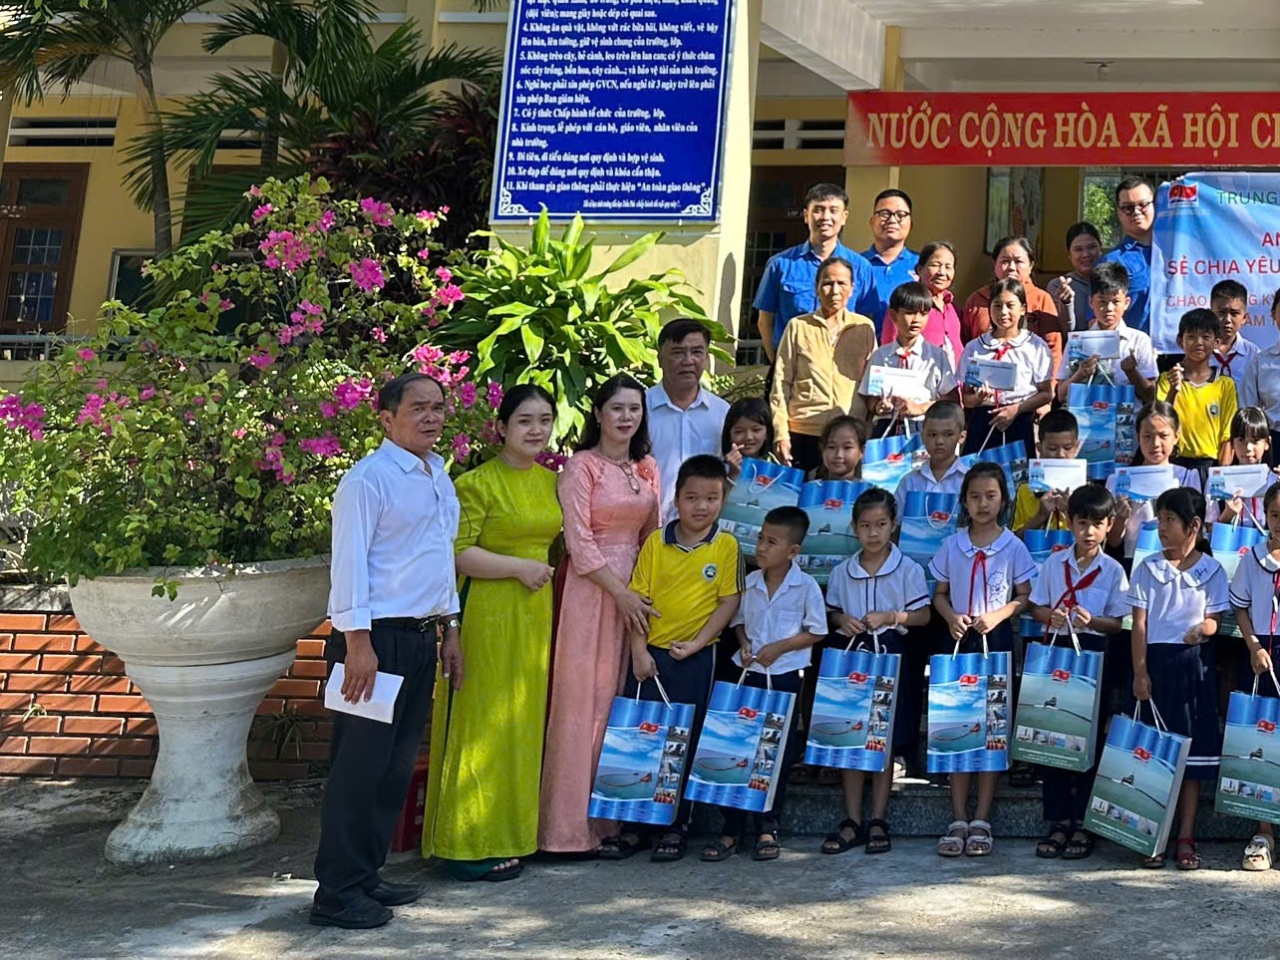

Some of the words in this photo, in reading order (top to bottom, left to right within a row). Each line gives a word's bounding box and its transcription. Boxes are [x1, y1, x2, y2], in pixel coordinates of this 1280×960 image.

[867, 101, 952, 149] NƯỚC
[959, 103, 1047, 157] CỘNG
[1053, 102, 1120, 148] HÒA
[1128, 104, 1174, 148] XÃ
[1182, 103, 1239, 157] HỘI
[1217, 192, 1278, 204] TRUNG
[1168, 255, 1188, 275] SẺ
[1194, 260, 1239, 274] CHIA
[1166, 292, 1207, 307] CHÀO
